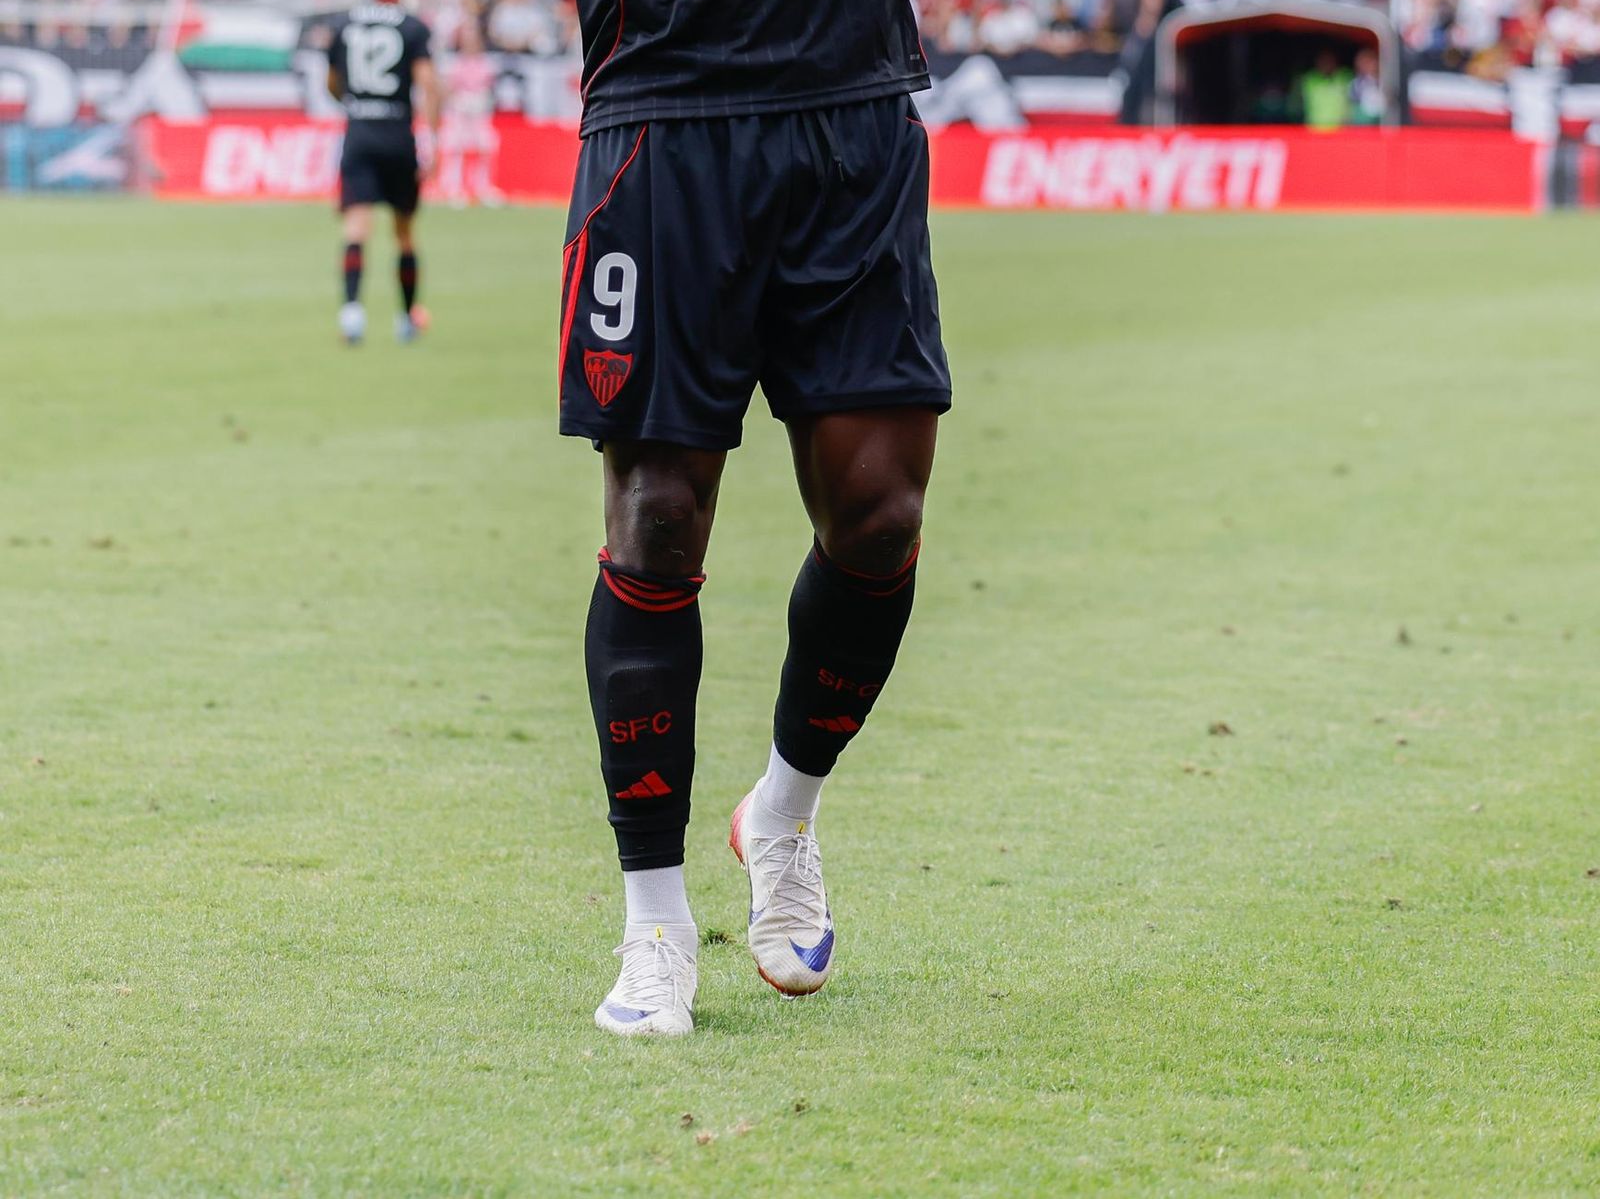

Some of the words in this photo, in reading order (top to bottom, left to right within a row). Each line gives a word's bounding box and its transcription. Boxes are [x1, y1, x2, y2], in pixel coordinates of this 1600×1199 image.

[341, 23, 404, 96] 12
[590, 251, 638, 342] 9
[817, 667, 881, 698] SFC
[609, 710, 672, 744] SFC
